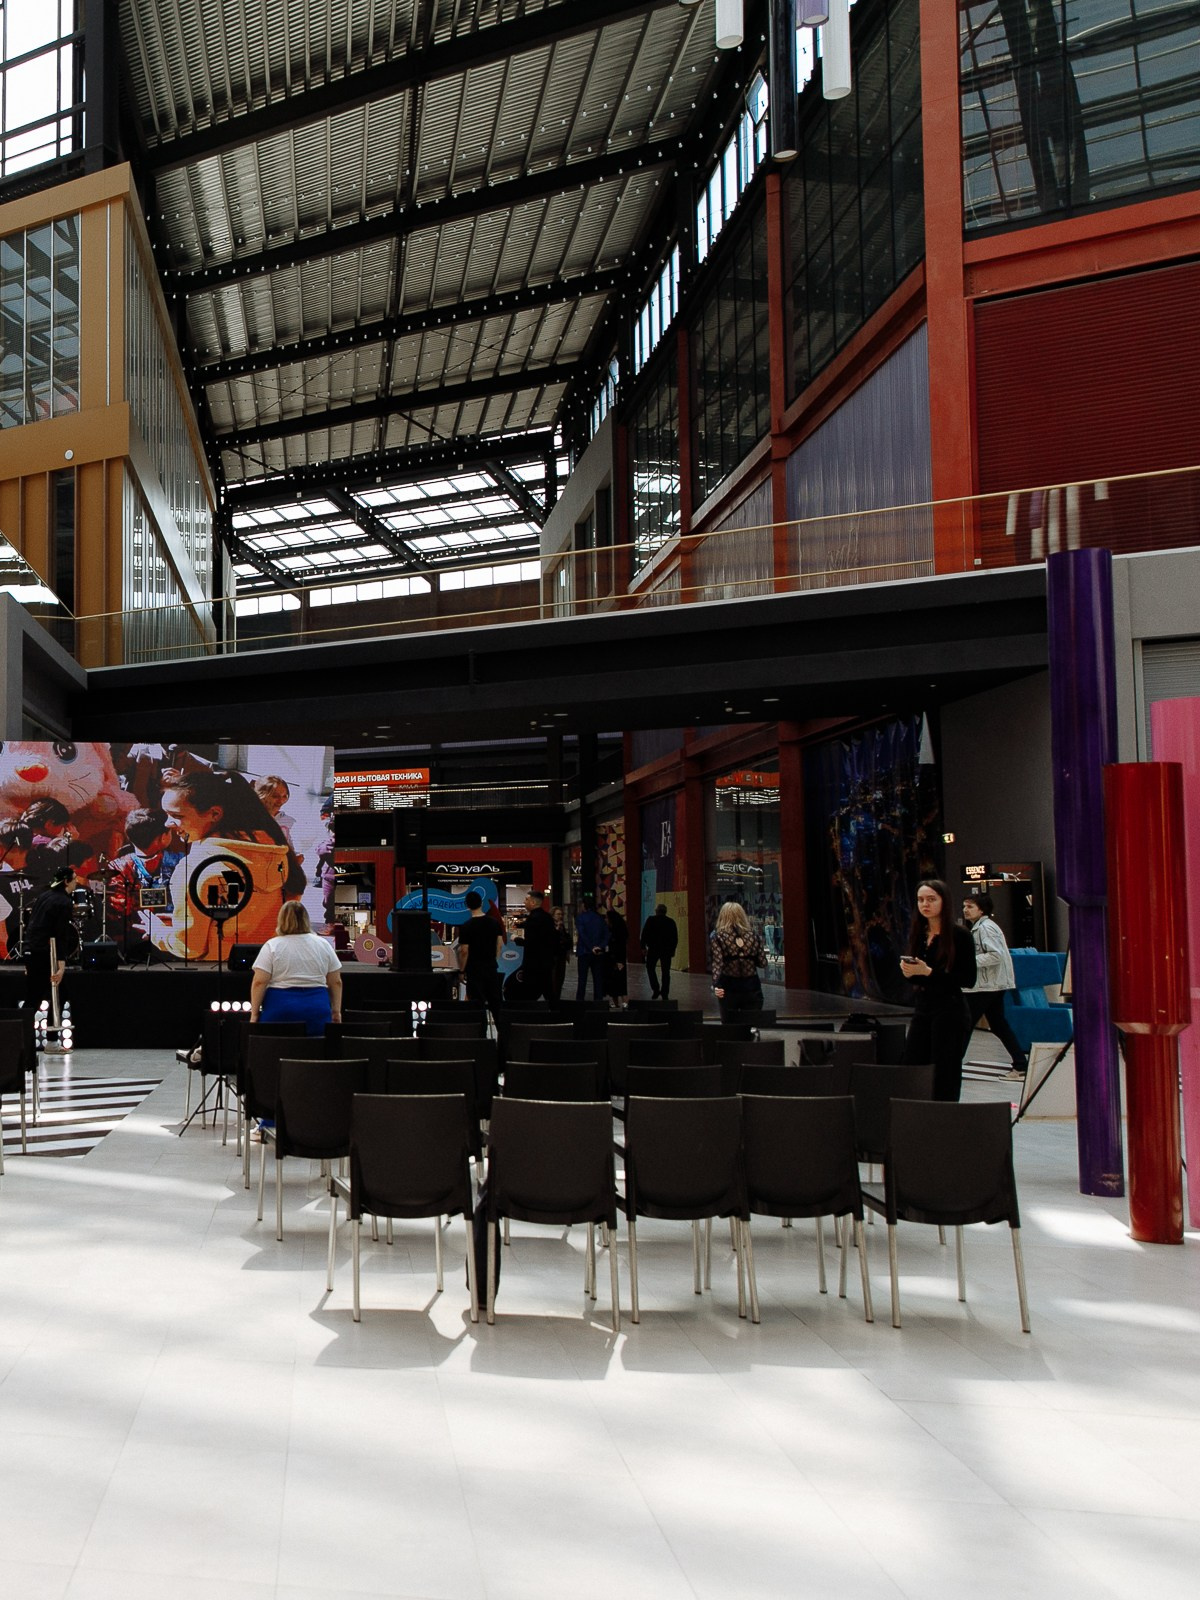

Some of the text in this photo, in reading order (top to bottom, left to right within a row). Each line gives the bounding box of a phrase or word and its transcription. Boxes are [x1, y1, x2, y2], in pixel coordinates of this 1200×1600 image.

[334, 775, 350, 783] ОВАЯ
[357, 773, 390, 783] БЫТОВАЯ
[391, 772, 423, 780] ТЕХНИКА
